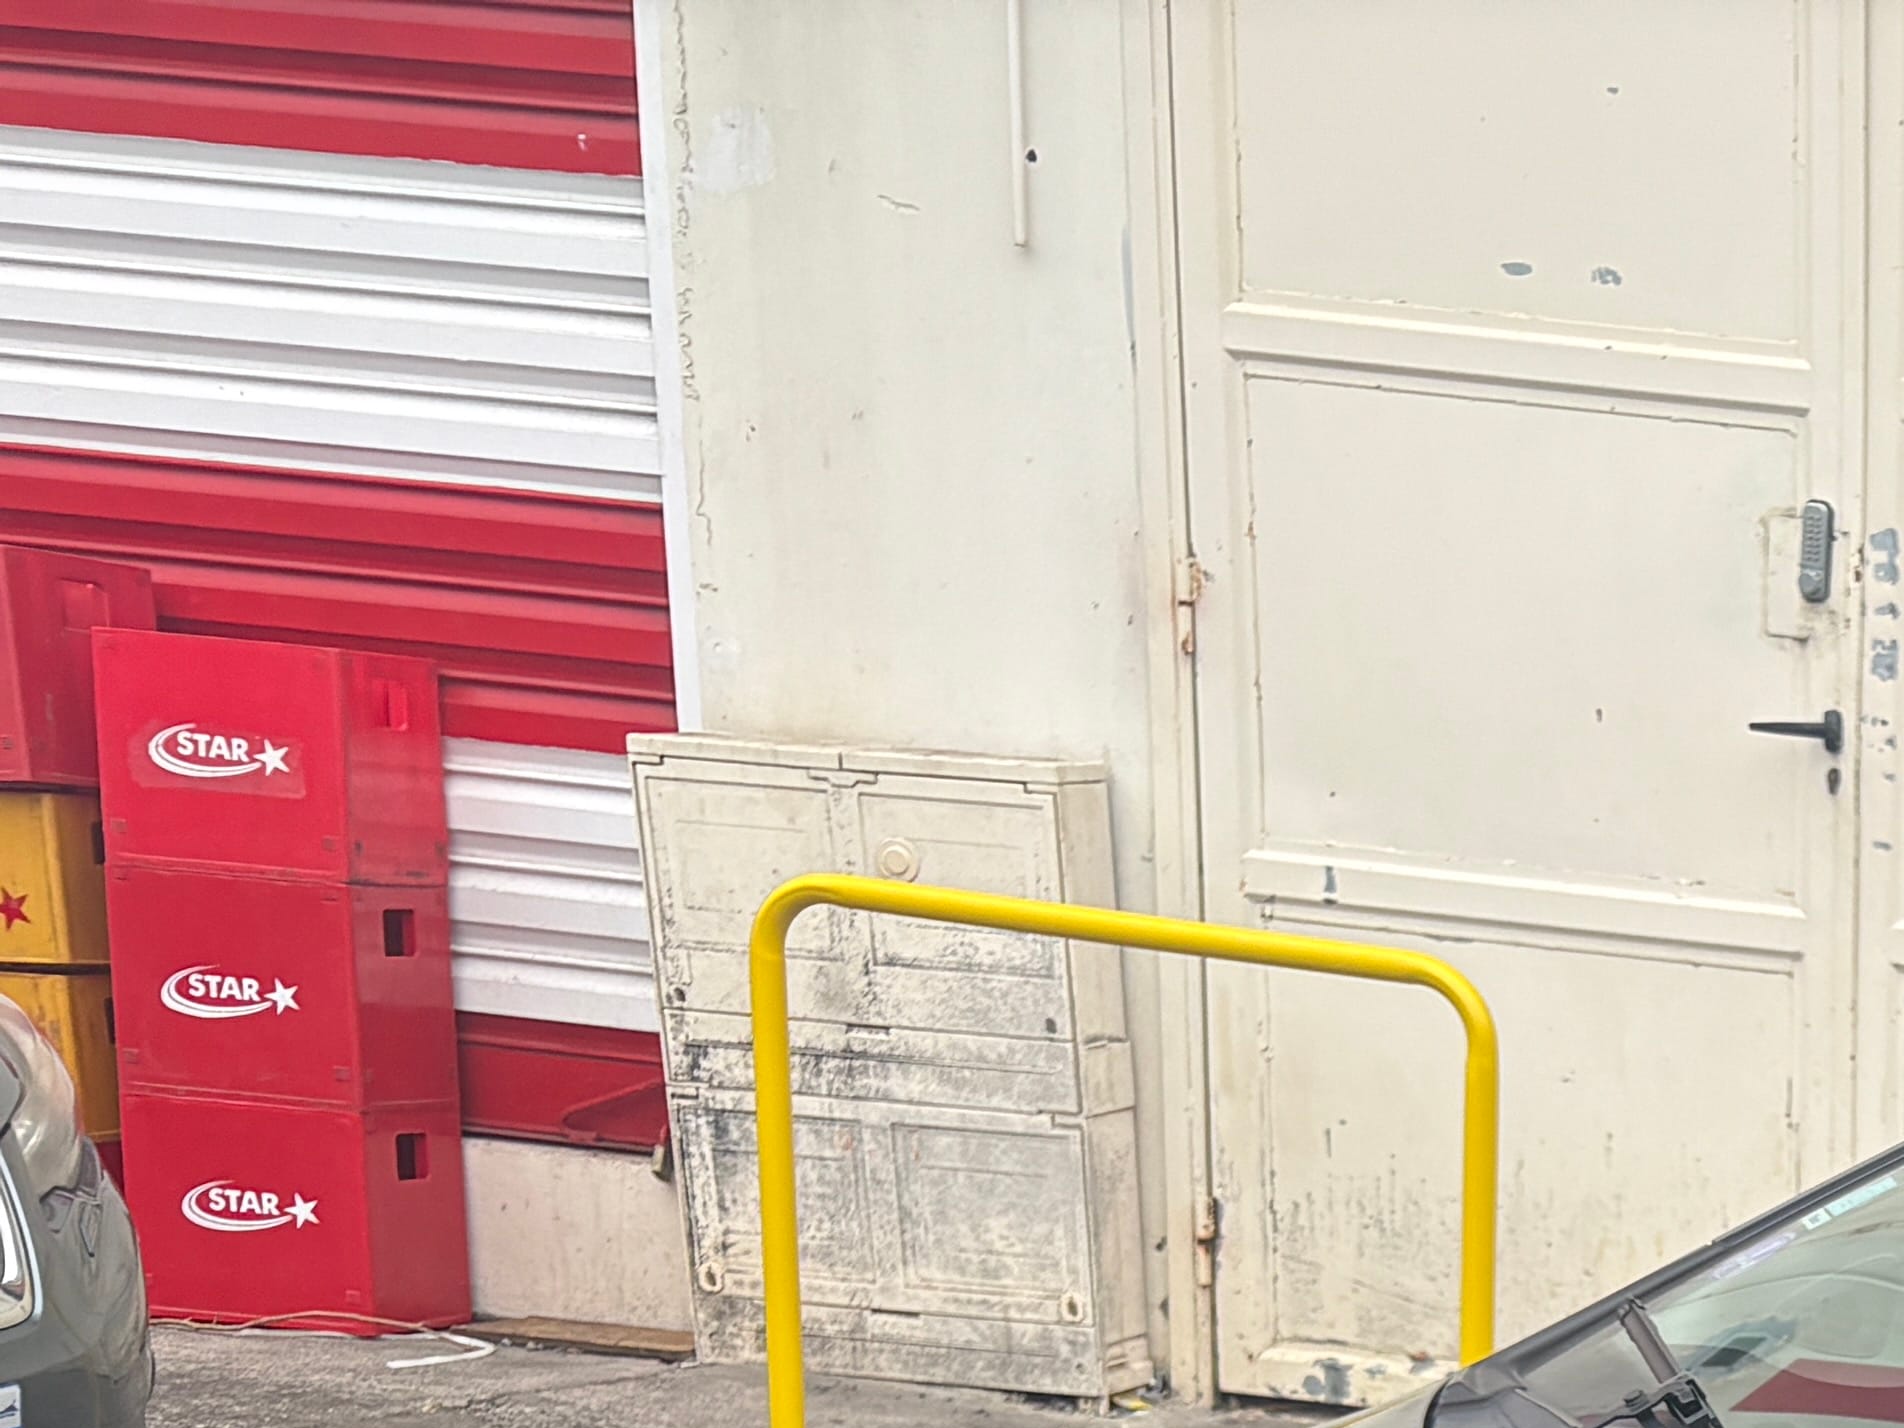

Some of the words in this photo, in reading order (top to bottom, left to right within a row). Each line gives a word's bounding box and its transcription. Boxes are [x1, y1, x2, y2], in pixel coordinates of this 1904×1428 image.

[176, 730, 249, 762] STAR
[187, 973, 260, 1002] STAR
[208, 1187, 280, 1216] STAR
